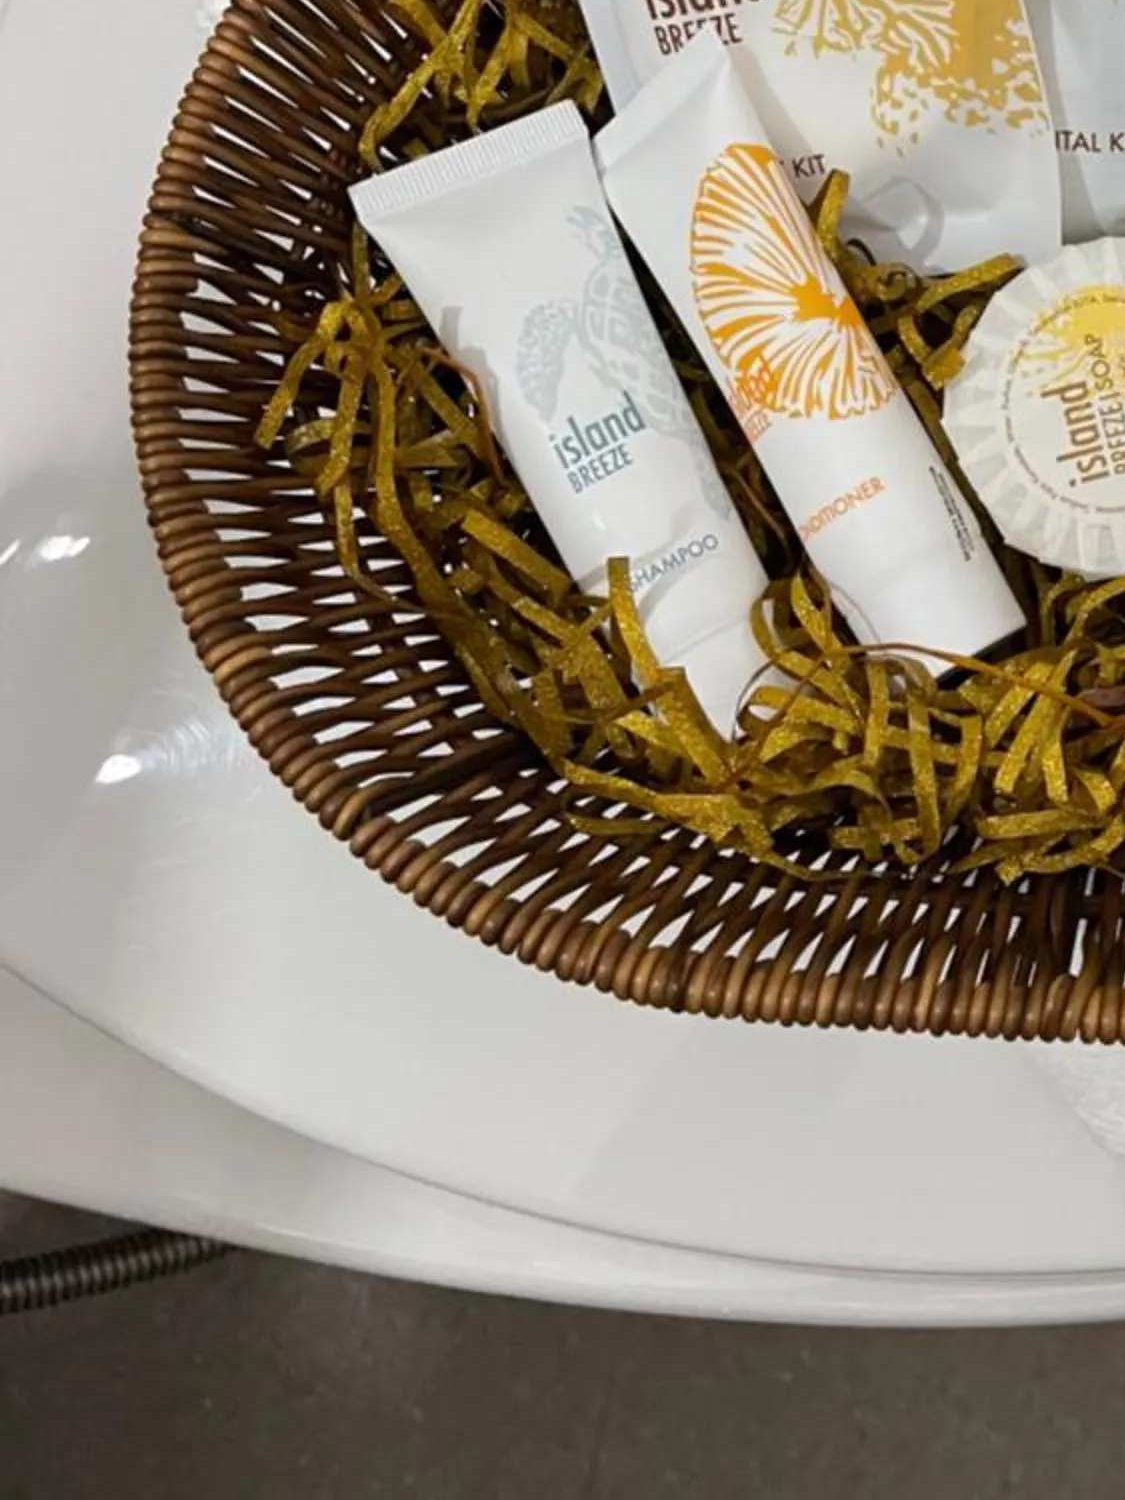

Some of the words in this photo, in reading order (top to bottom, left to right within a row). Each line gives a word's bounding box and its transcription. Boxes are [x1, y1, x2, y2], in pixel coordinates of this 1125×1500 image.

[791, 154, 827, 179] KIT
[1084, 333, 1113, 391] SOAP
[549, 389, 646, 470] island
[1040, 380, 1110, 488] island
[567, 443, 633, 494] BREEZE
